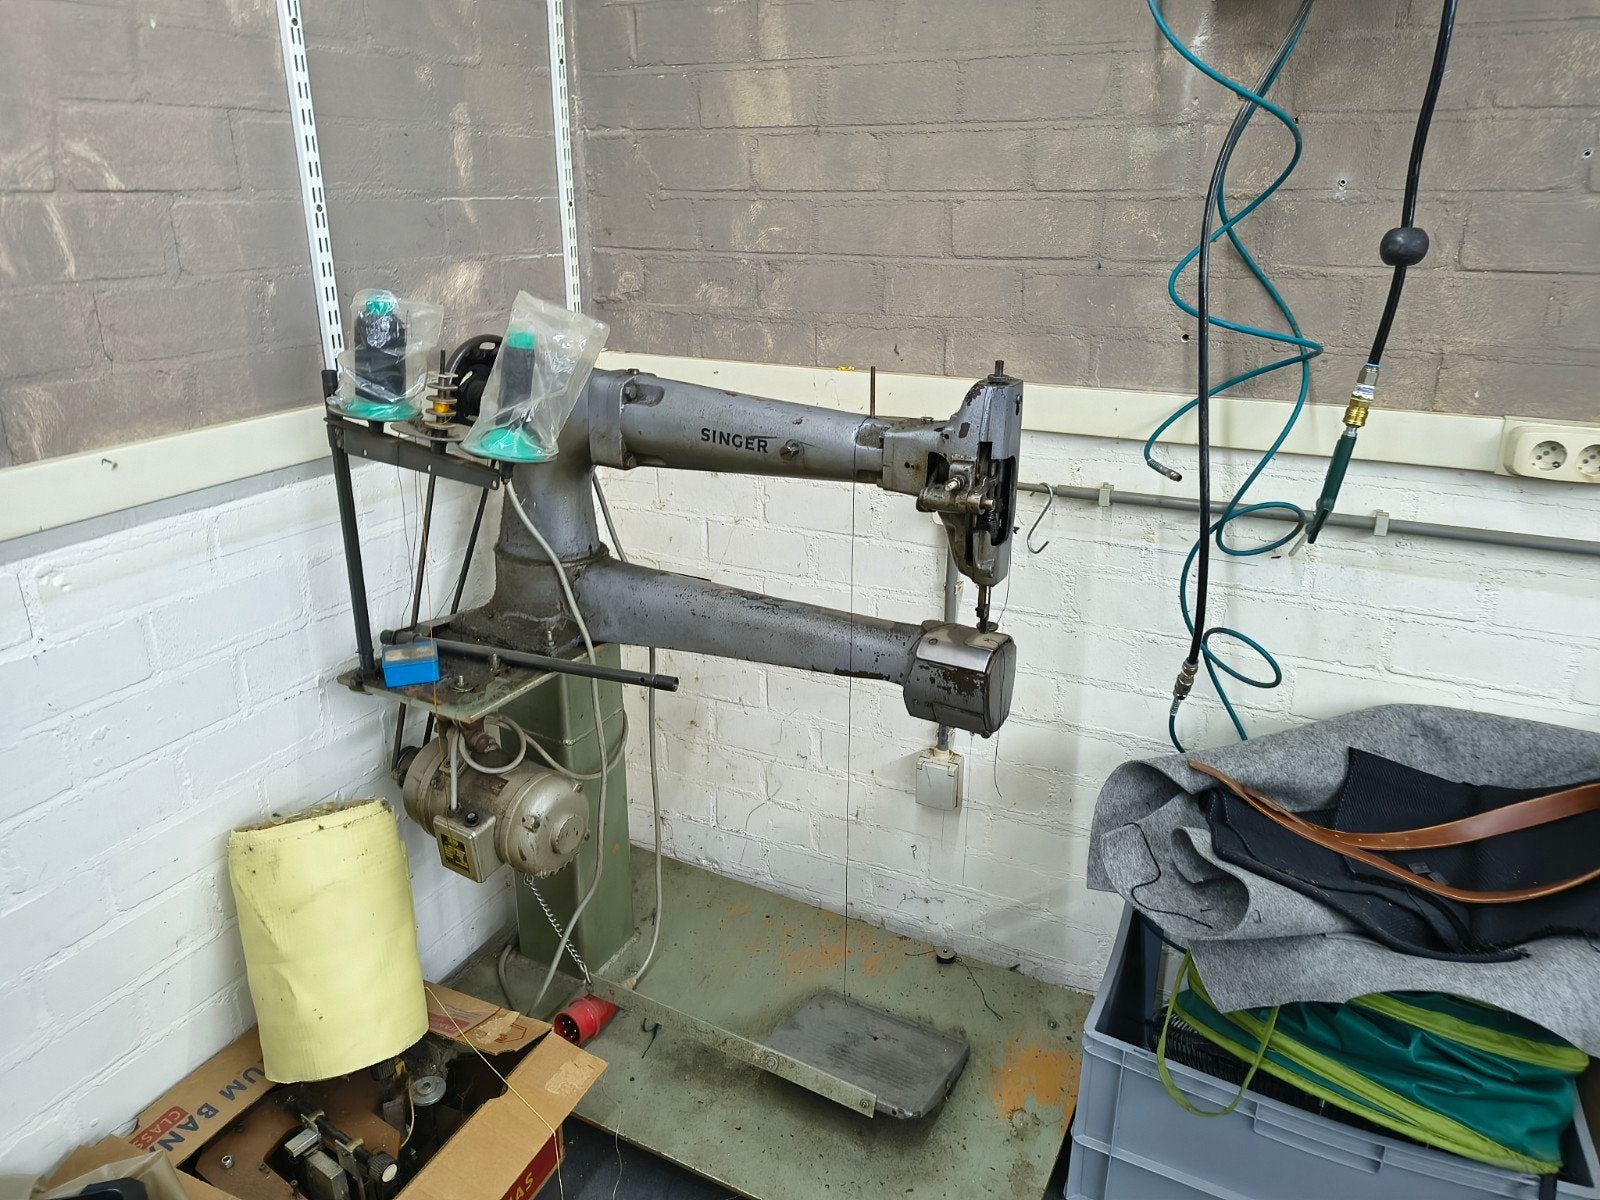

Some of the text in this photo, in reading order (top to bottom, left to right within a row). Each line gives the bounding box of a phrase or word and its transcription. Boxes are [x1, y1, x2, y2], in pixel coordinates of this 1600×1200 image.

[701, 427, 768, 453] SINGER
[149, 1059, 265, 1152] UM BAN
[509, 1171, 533, 1200] AS
